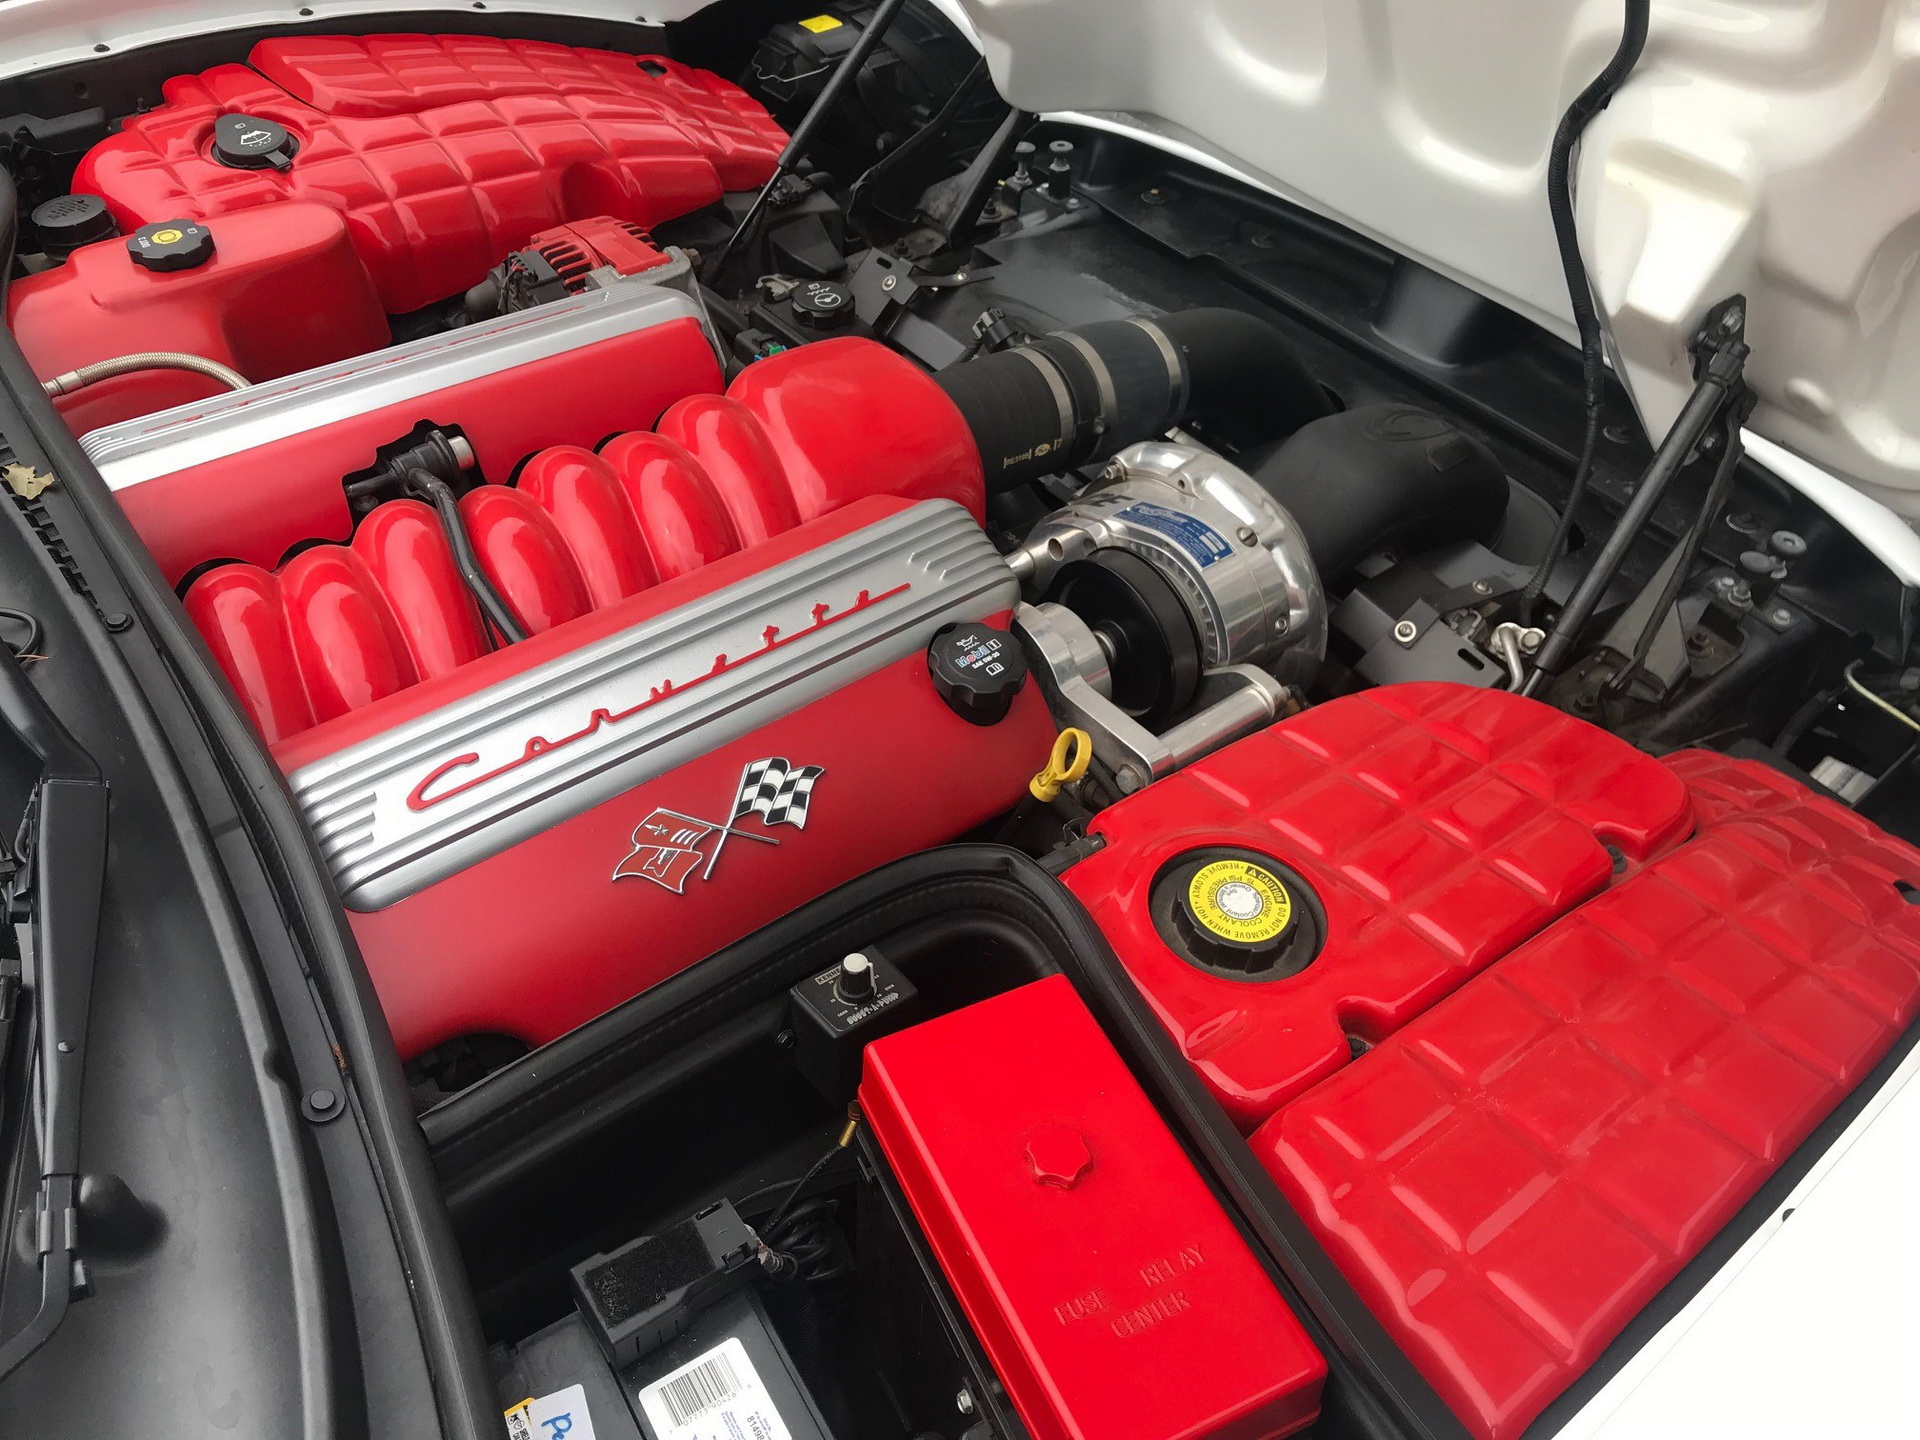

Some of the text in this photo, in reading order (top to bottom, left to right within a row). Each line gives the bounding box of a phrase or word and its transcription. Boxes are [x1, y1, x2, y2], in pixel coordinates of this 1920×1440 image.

[955, 644, 991, 668] Mobil
[407, 582, 912, 813] Corvette
[1192, 862, 1240, 898] REMOVE SLOWLY
[1207, 874, 1255, 911] 15 PSI PRESSURE
[1257, 872, 1286, 904] CAUTION
[1196, 904, 1287, 940] DO NOT REMOVE WHEN HOT
[1218, 888, 1273, 927] ENGINE COOLANT
[1053, 1242, 1205, 1326] FUSE RELAY
[1110, 1289, 1191, 1338] CENTER
